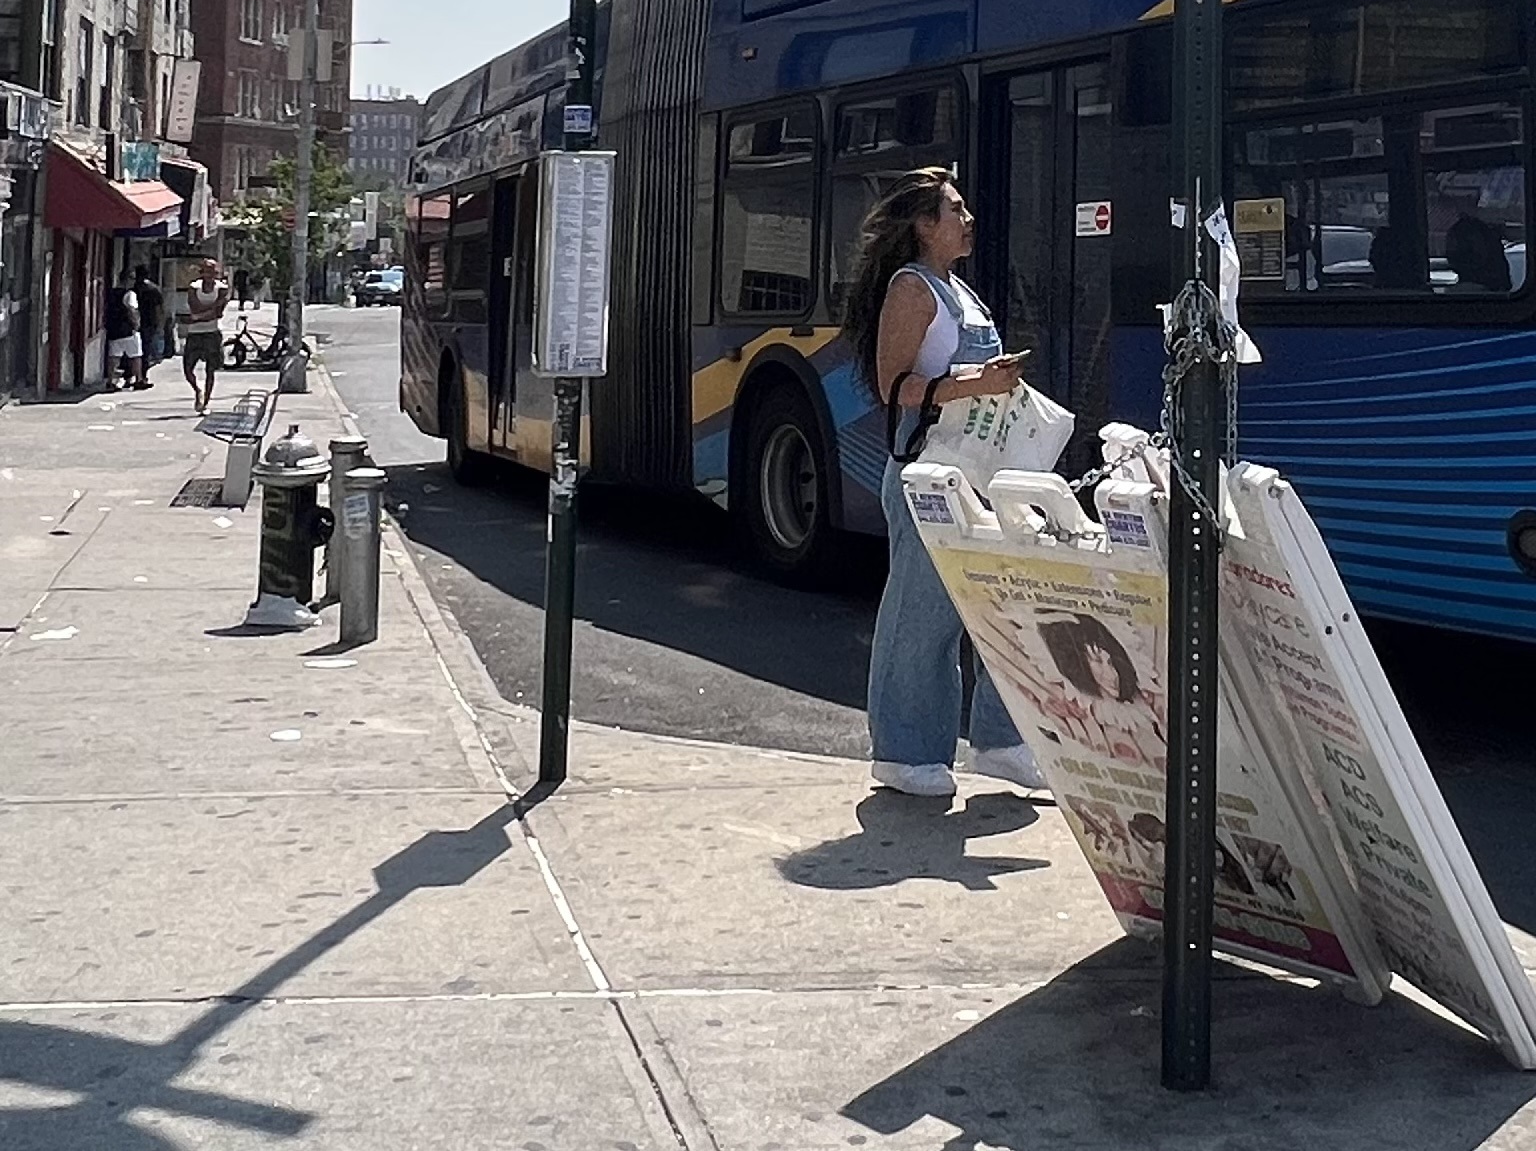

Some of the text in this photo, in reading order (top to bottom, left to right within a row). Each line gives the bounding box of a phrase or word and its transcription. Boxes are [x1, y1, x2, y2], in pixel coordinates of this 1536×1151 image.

[1322, 742, 1367, 781] ACD
[1340, 778, 1384, 818] ACS
[1340, 801, 1418, 864] Welfare
[1359, 841, 1433, 899] Private
